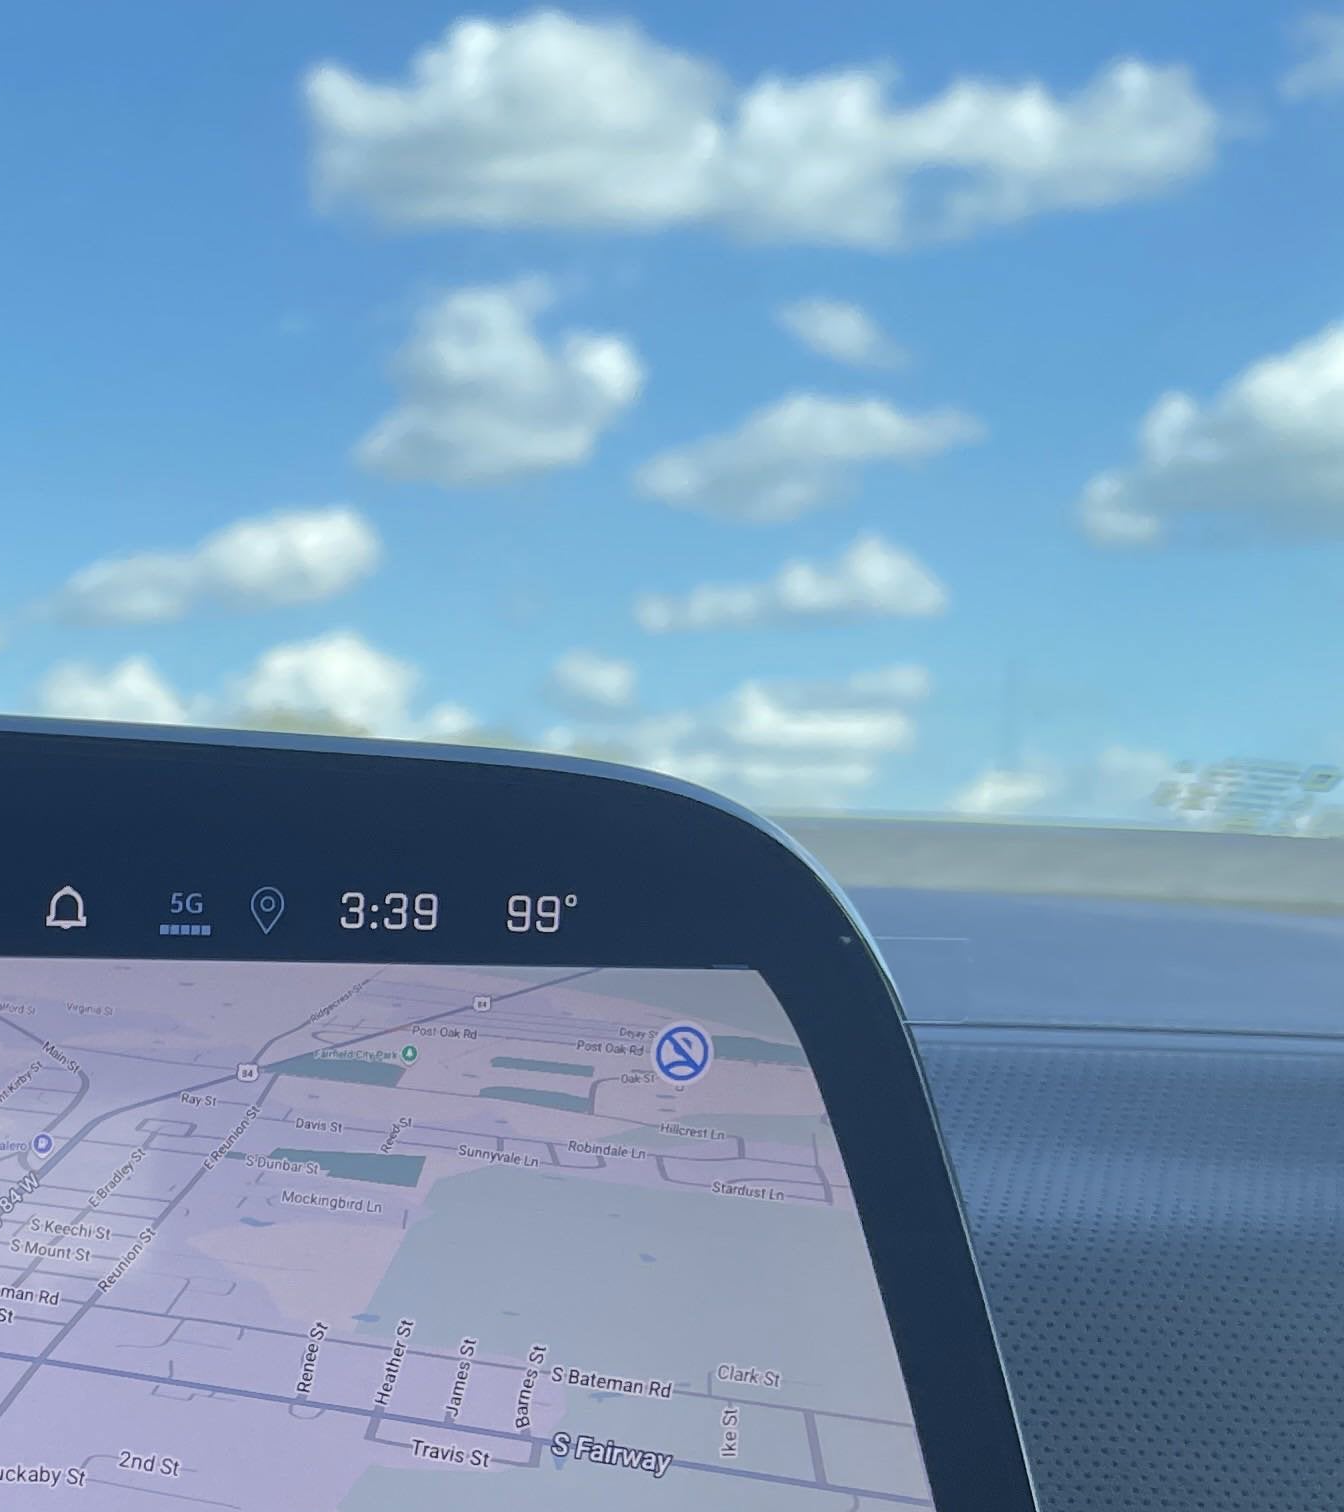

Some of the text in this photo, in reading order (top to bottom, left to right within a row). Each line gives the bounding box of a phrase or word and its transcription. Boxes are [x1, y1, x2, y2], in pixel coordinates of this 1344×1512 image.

[169, 892, 204, 915] 5G
[340, 892, 438, 931] 3:39
[507, 894, 578, 933] 99°
[412, 1025, 477, 1040] Post Oak Rd
[314, 1049, 398, 1061] Fairfield City Park
[295, 1117, 343, 1133] Davis St
[458, 1145, 539, 1167] Sunnyvale Ln
[19, 1170, 41, 1193] W
[88, 1147, 146, 1209] E Bradley St
[281, 1190, 383, 1213] Mockingbird Ln
[712, 1181, 785, 1201] Stardust Ln
[30, 1218, 111, 1241] S Keechi St
[10, 1239, 91, 1262] S Mount St
[97, 1226, 156, 1293] Reunion St
[38, 1289, 60, 1306] Rd
[296, 1320, 329, 1394] Renee St
[374, 1319, 415, 1406] Heather St
[446, 1337, 477, 1418] James St
[515, 1344, 548, 1429] Barnes St
[551, 1367, 672, 1399] S Bateman Rd
[717, 1364, 781, 1388] Clark St
[720, 1407, 739, 1457] Ike St
[119, 1451, 180, 1476] 2nd St
[412, 1440, 490, 1468] Travis St
[551, 1432, 673, 1479] S Fairway
[66, 1468, 86, 1487] St
